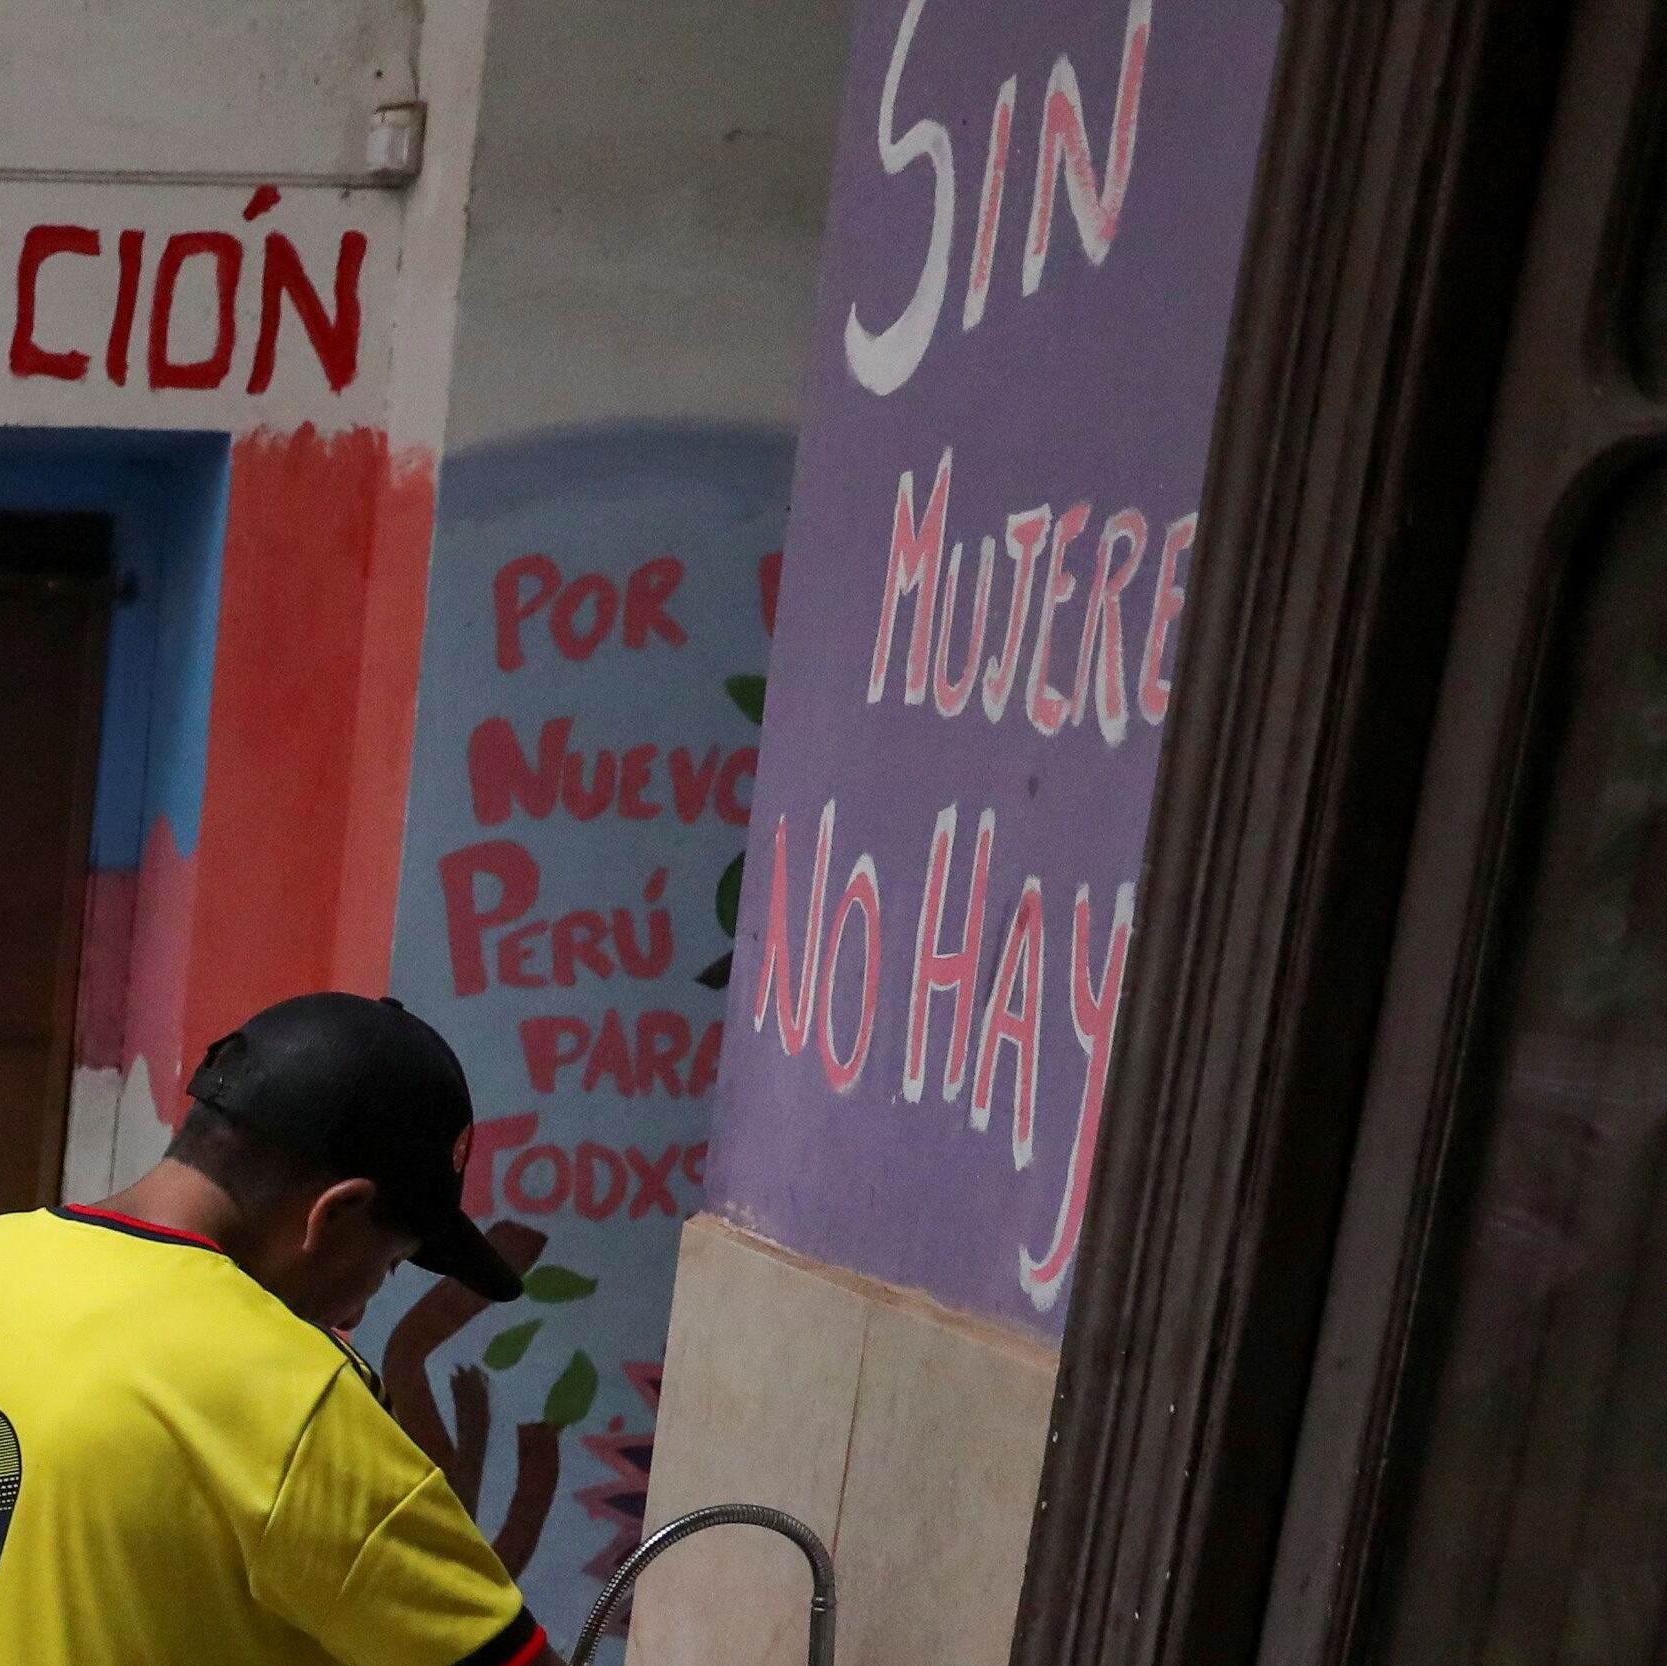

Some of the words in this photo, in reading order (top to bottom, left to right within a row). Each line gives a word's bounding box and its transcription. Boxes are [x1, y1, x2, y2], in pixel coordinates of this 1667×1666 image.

[844, 0, 1152, 396] SIN
[493, 552, 689, 674] POR
[438, 839, 675, 998] PERÚ
[753, 797, 883, 1094] NO
